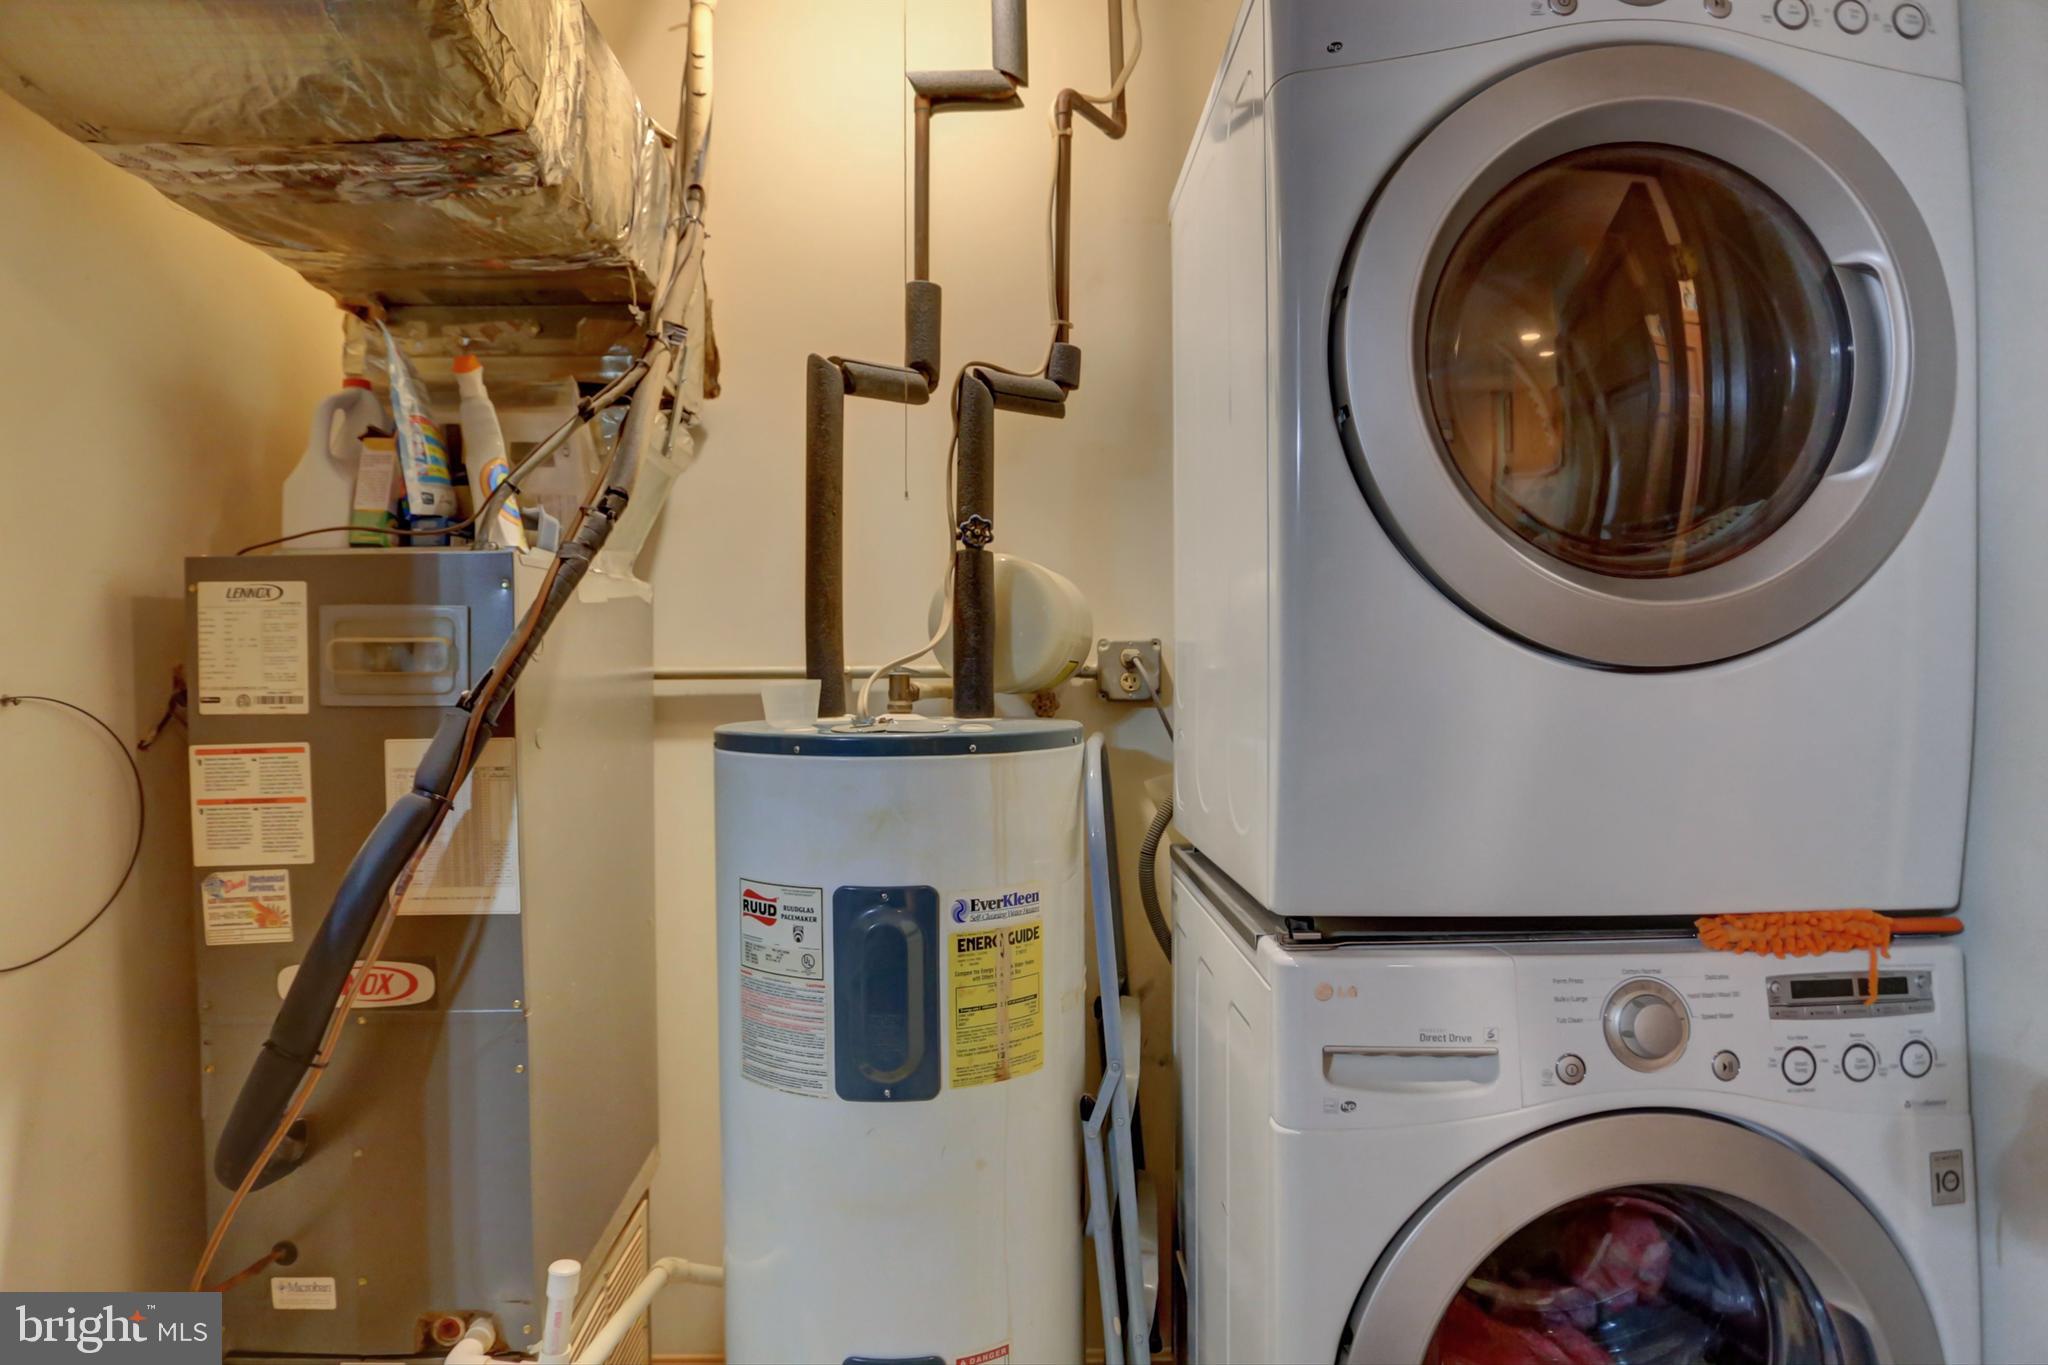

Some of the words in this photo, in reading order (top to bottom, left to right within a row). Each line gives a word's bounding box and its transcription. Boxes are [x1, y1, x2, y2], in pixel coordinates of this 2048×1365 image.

[226, 587, 273, 600] LENNOX
[743, 899, 777, 917] RUUD
[783, 904, 815, 914] RUUDGLAS
[971, 892, 1040, 912] EverKleen
[781, 914, 818, 924] PACEMAKER
[1008, 926, 1040, 945] GUIDE
[1419, 1032, 1447, 1043] Direct
[1448, 1033, 1473, 1043] Drive
[1936, 1170, 1960, 1194] 10
[970, 1347, 1007, 1365] DANGER
